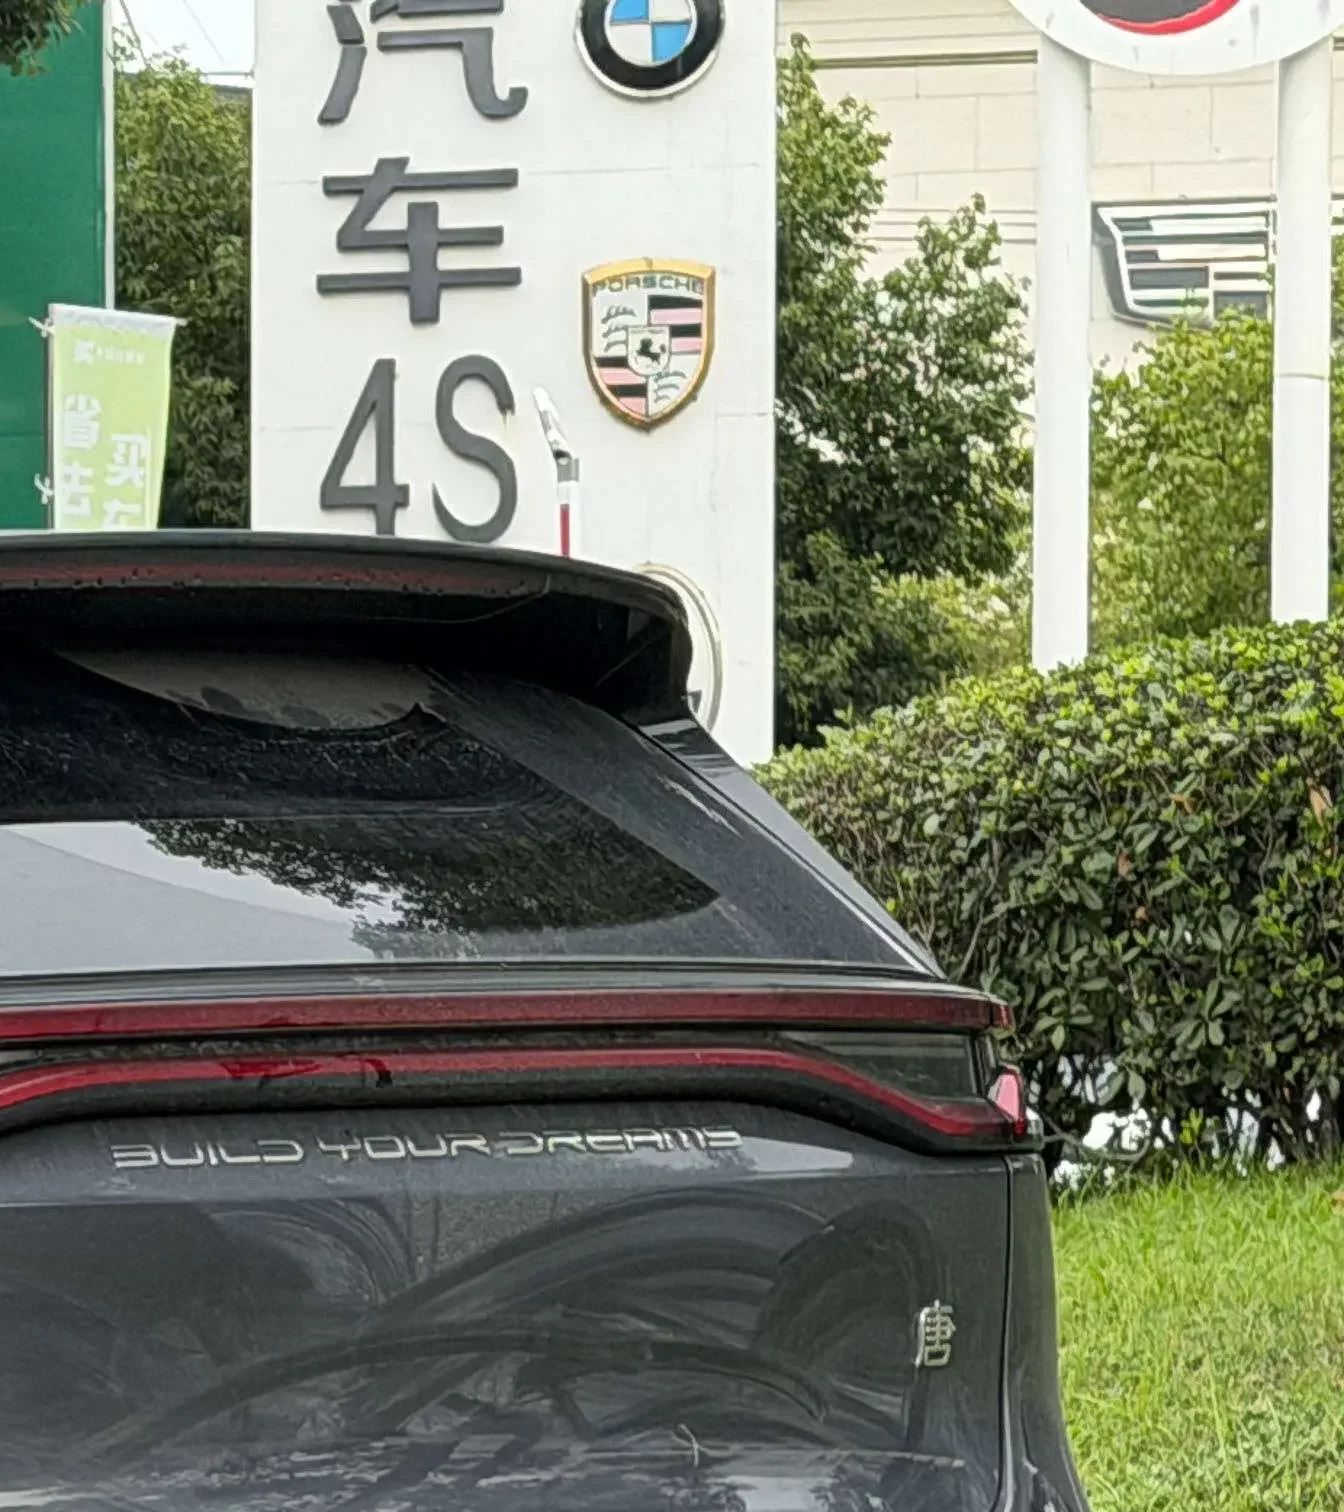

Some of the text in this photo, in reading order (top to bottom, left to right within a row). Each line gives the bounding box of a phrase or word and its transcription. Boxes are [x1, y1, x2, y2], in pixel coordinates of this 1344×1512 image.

[592, 273, 704, 297] PORSCHE
[111, 1125, 745, 1169] BUILD YOUR DREAMS
